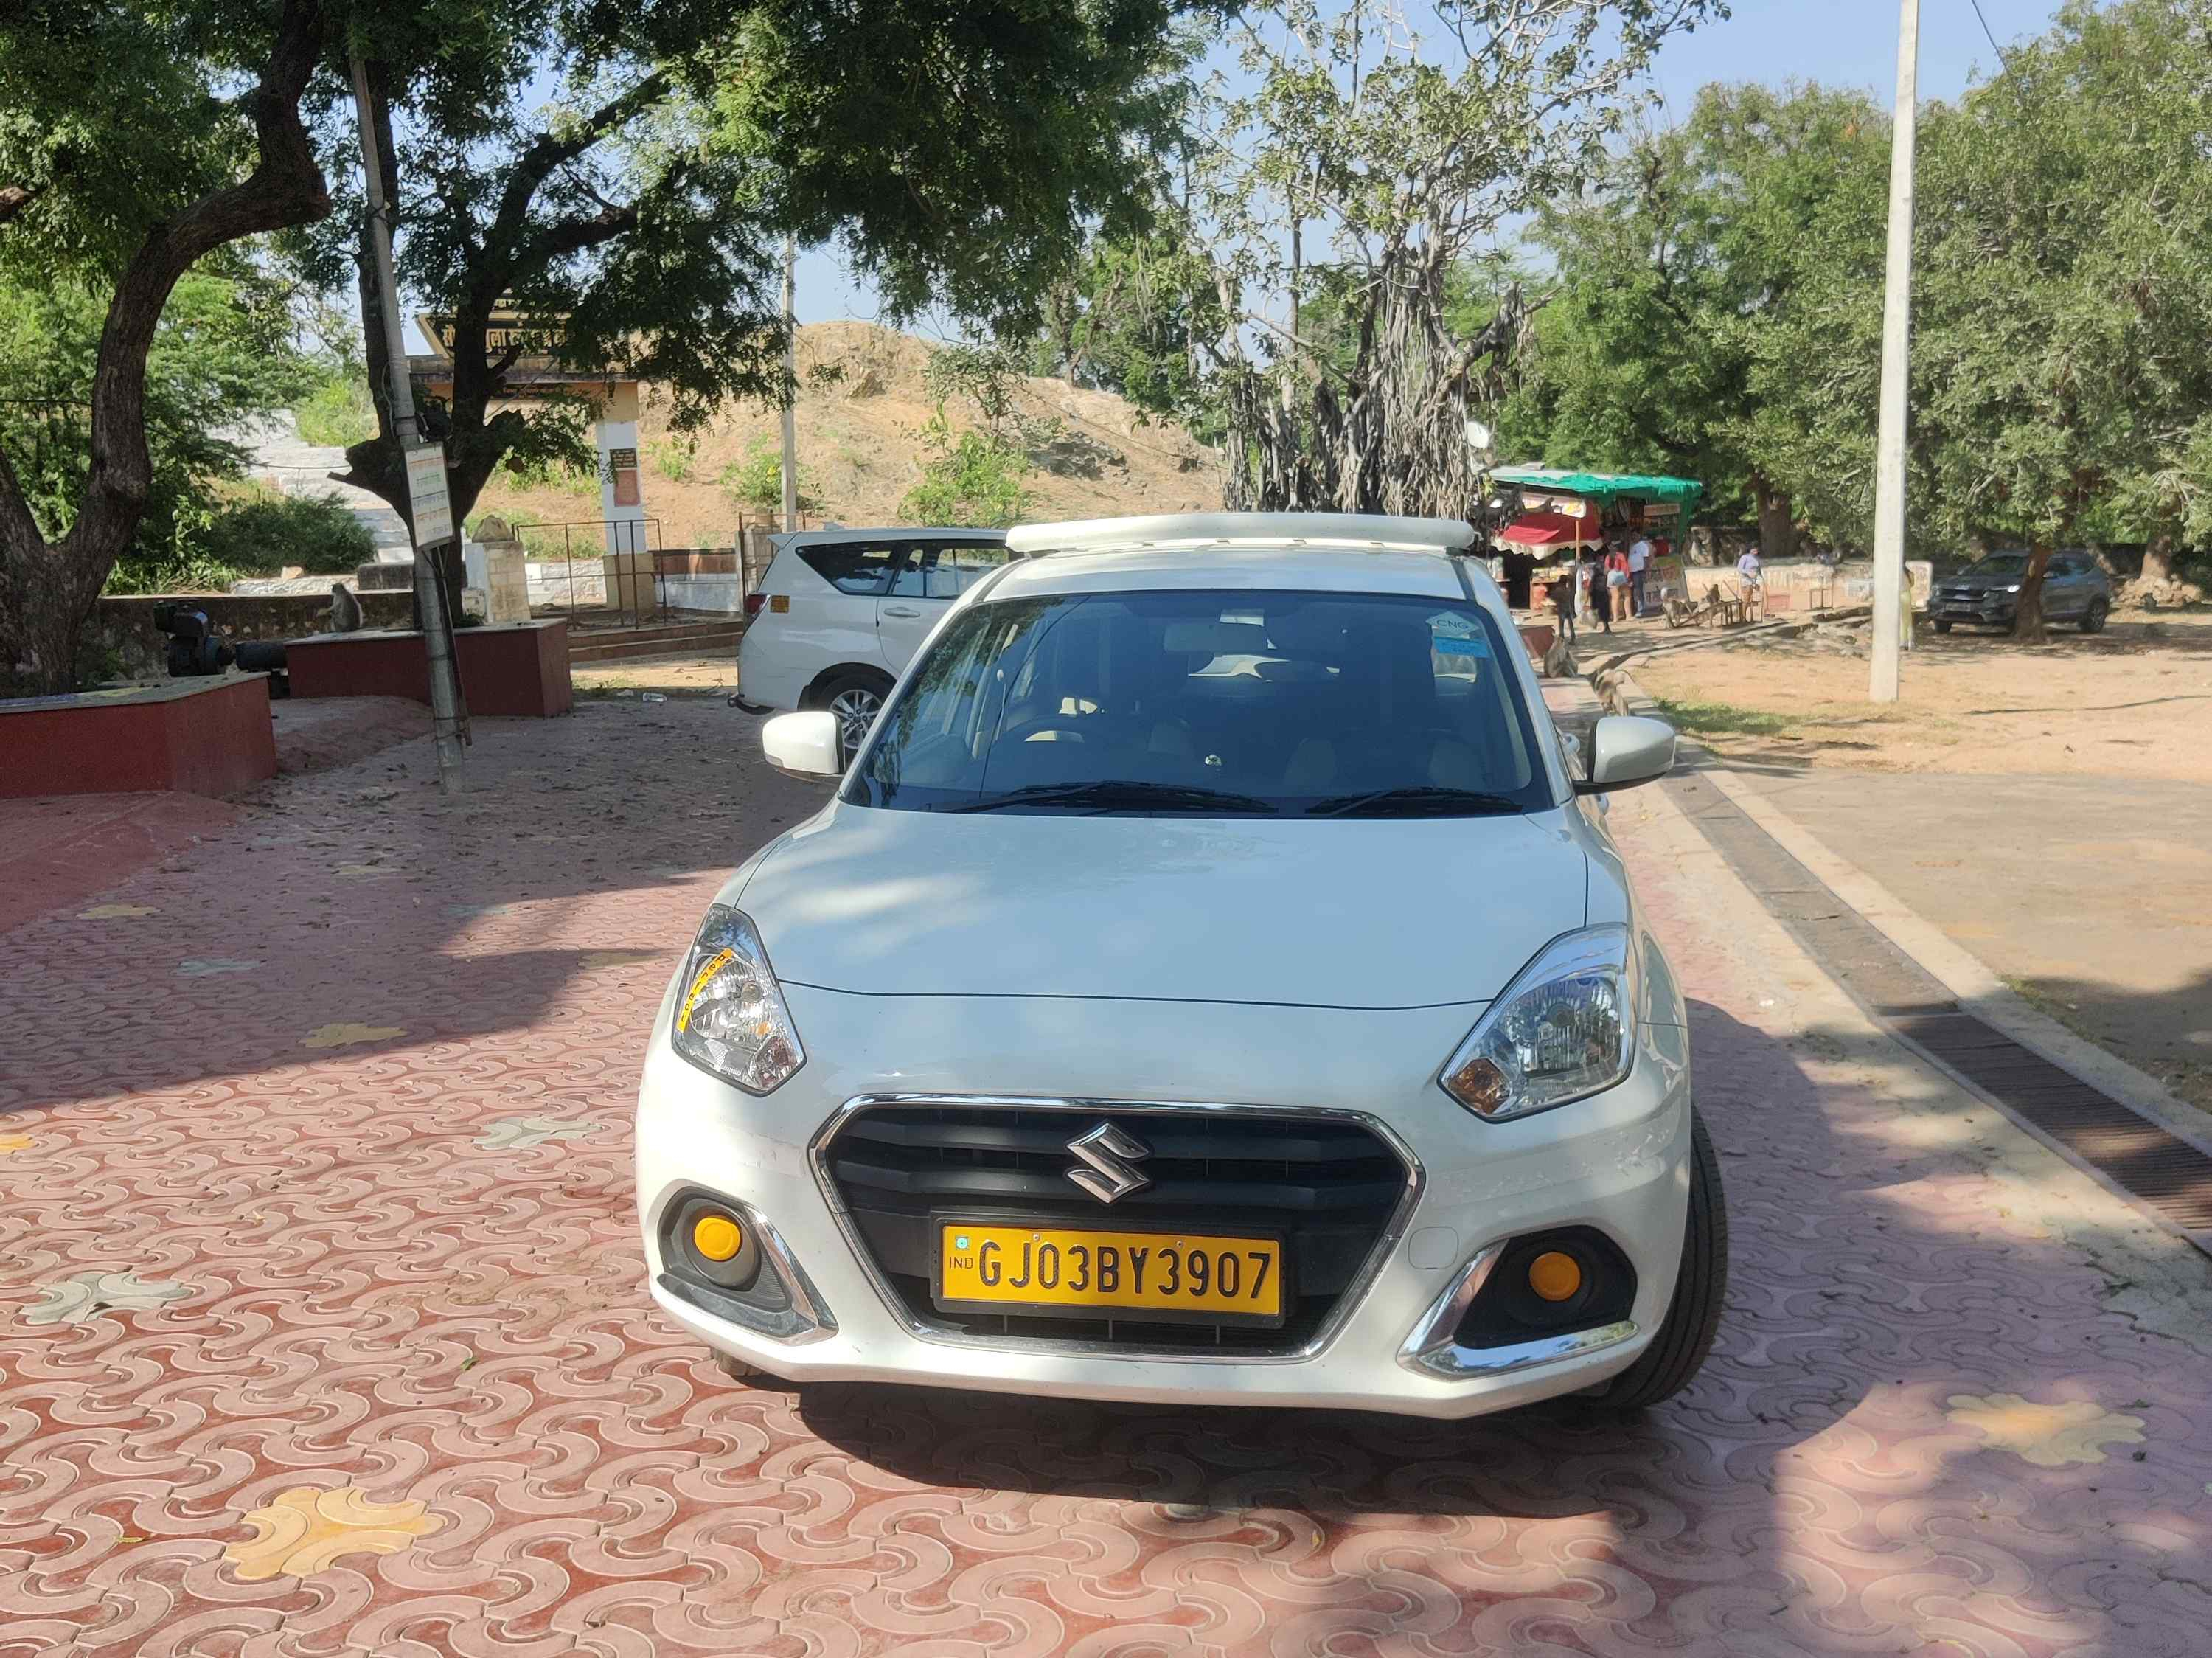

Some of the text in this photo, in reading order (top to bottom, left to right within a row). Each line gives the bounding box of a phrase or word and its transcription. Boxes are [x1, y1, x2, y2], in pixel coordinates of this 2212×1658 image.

[1436, 620, 1468, 629] CNG
[949, 1241, 1270, 1299] IND GJ03BY3907
